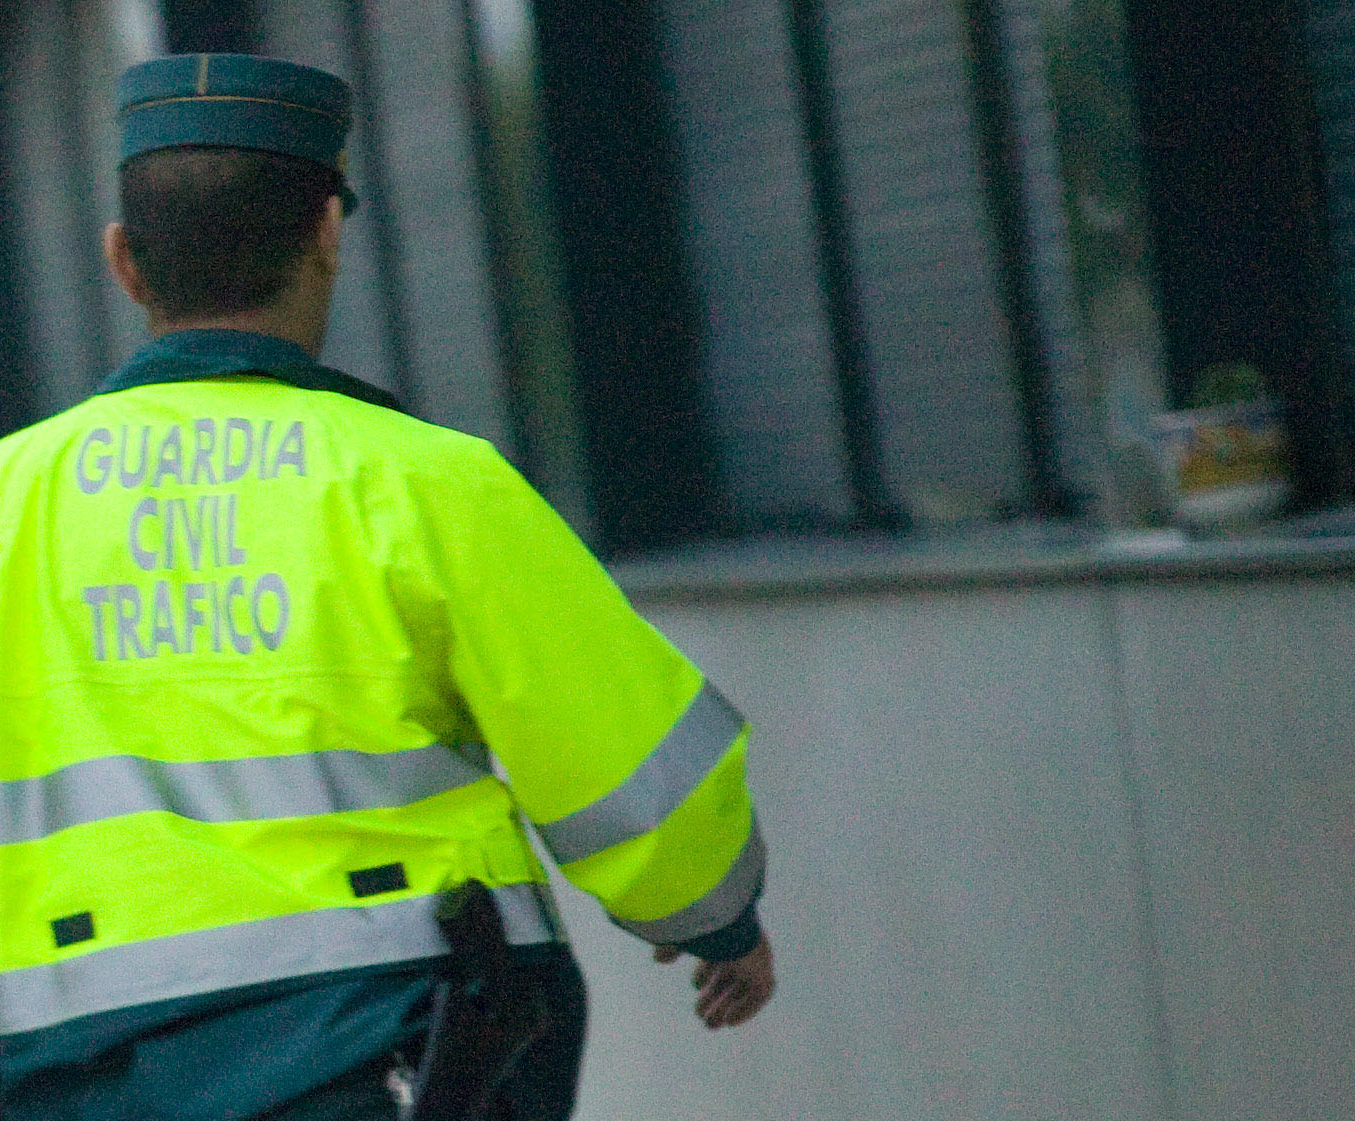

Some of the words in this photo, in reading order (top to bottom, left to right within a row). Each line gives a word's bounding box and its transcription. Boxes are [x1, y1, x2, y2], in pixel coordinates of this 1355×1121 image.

[76, 418, 306, 494] GUARDIA
[129, 494, 247, 571] CIVIL
[82, 573, 290, 661] TRAFICO
